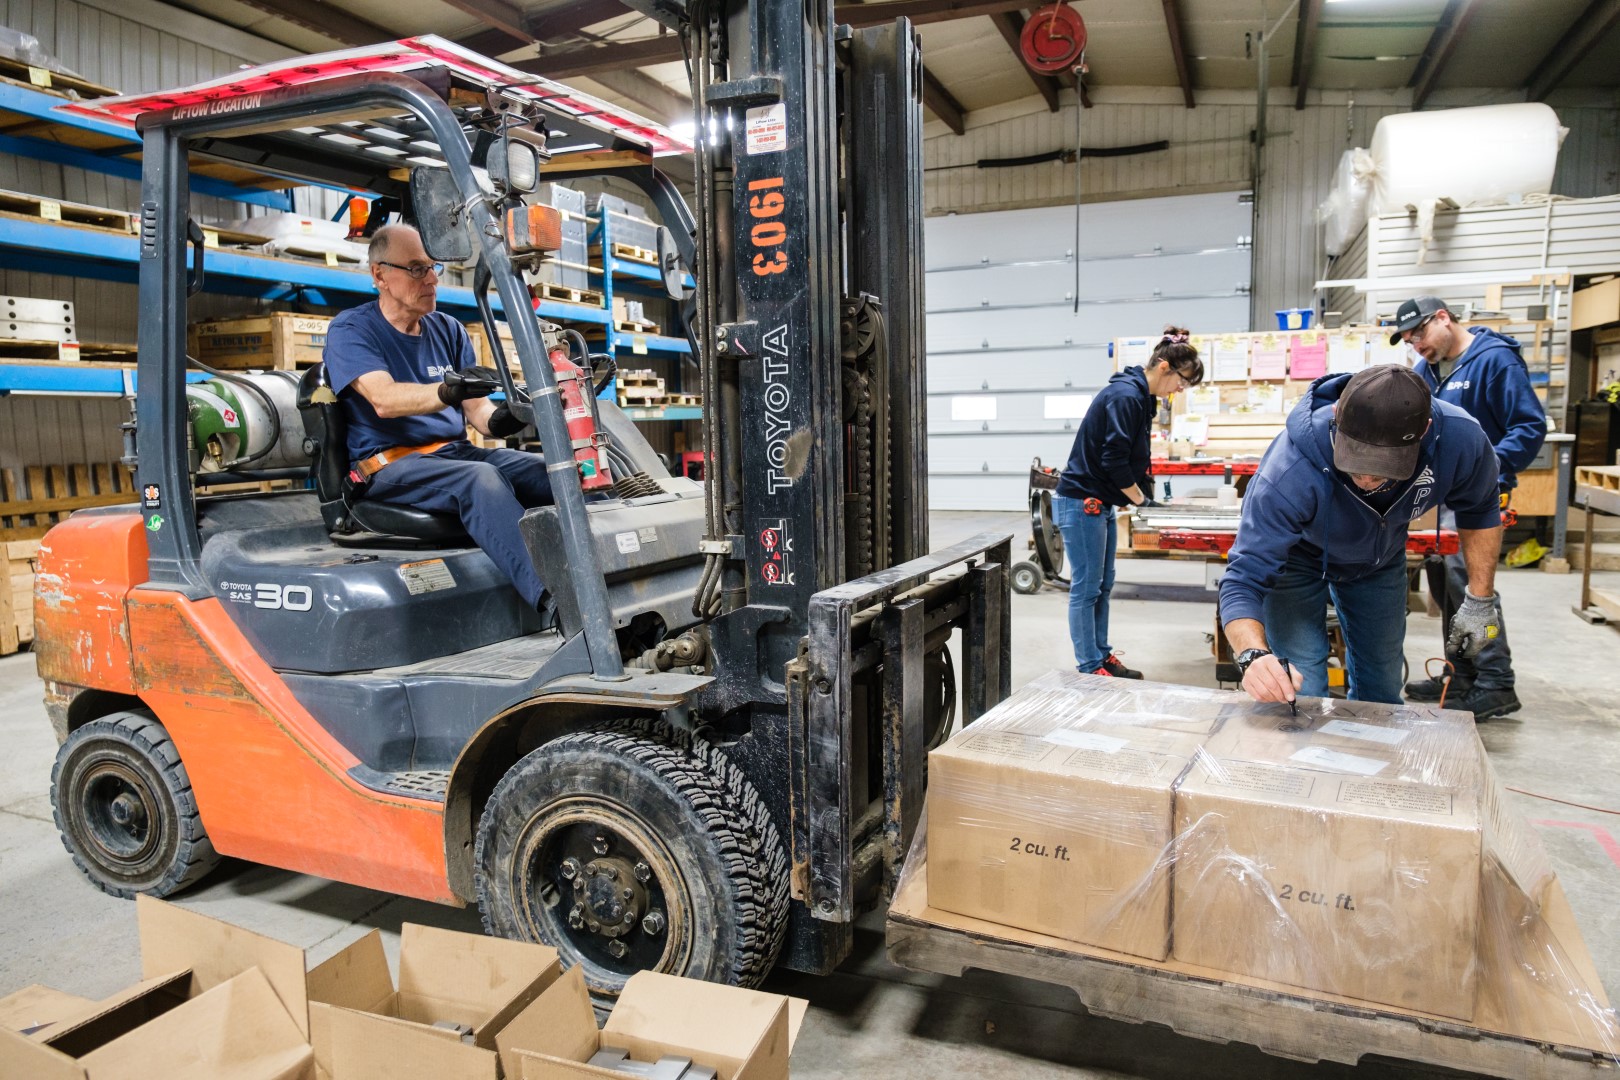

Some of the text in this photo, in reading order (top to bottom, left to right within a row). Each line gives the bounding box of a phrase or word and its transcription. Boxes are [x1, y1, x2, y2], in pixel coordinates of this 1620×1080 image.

[172, 95, 262, 120] LIFTOW LOCATION
[748, 177, 788, 276] 1903
[762, 323, 793, 495] TOYOTA
[145, 485, 160, 500] SAS
[229, 582, 252, 592] TOYOTA
[230, 591, 251, 601] SAS
[254, 582, 313, 612] 30
[1009, 837, 1070, 861] 2 cu. ft.
[1279, 884, 1355, 911] 2 cu. ft.
